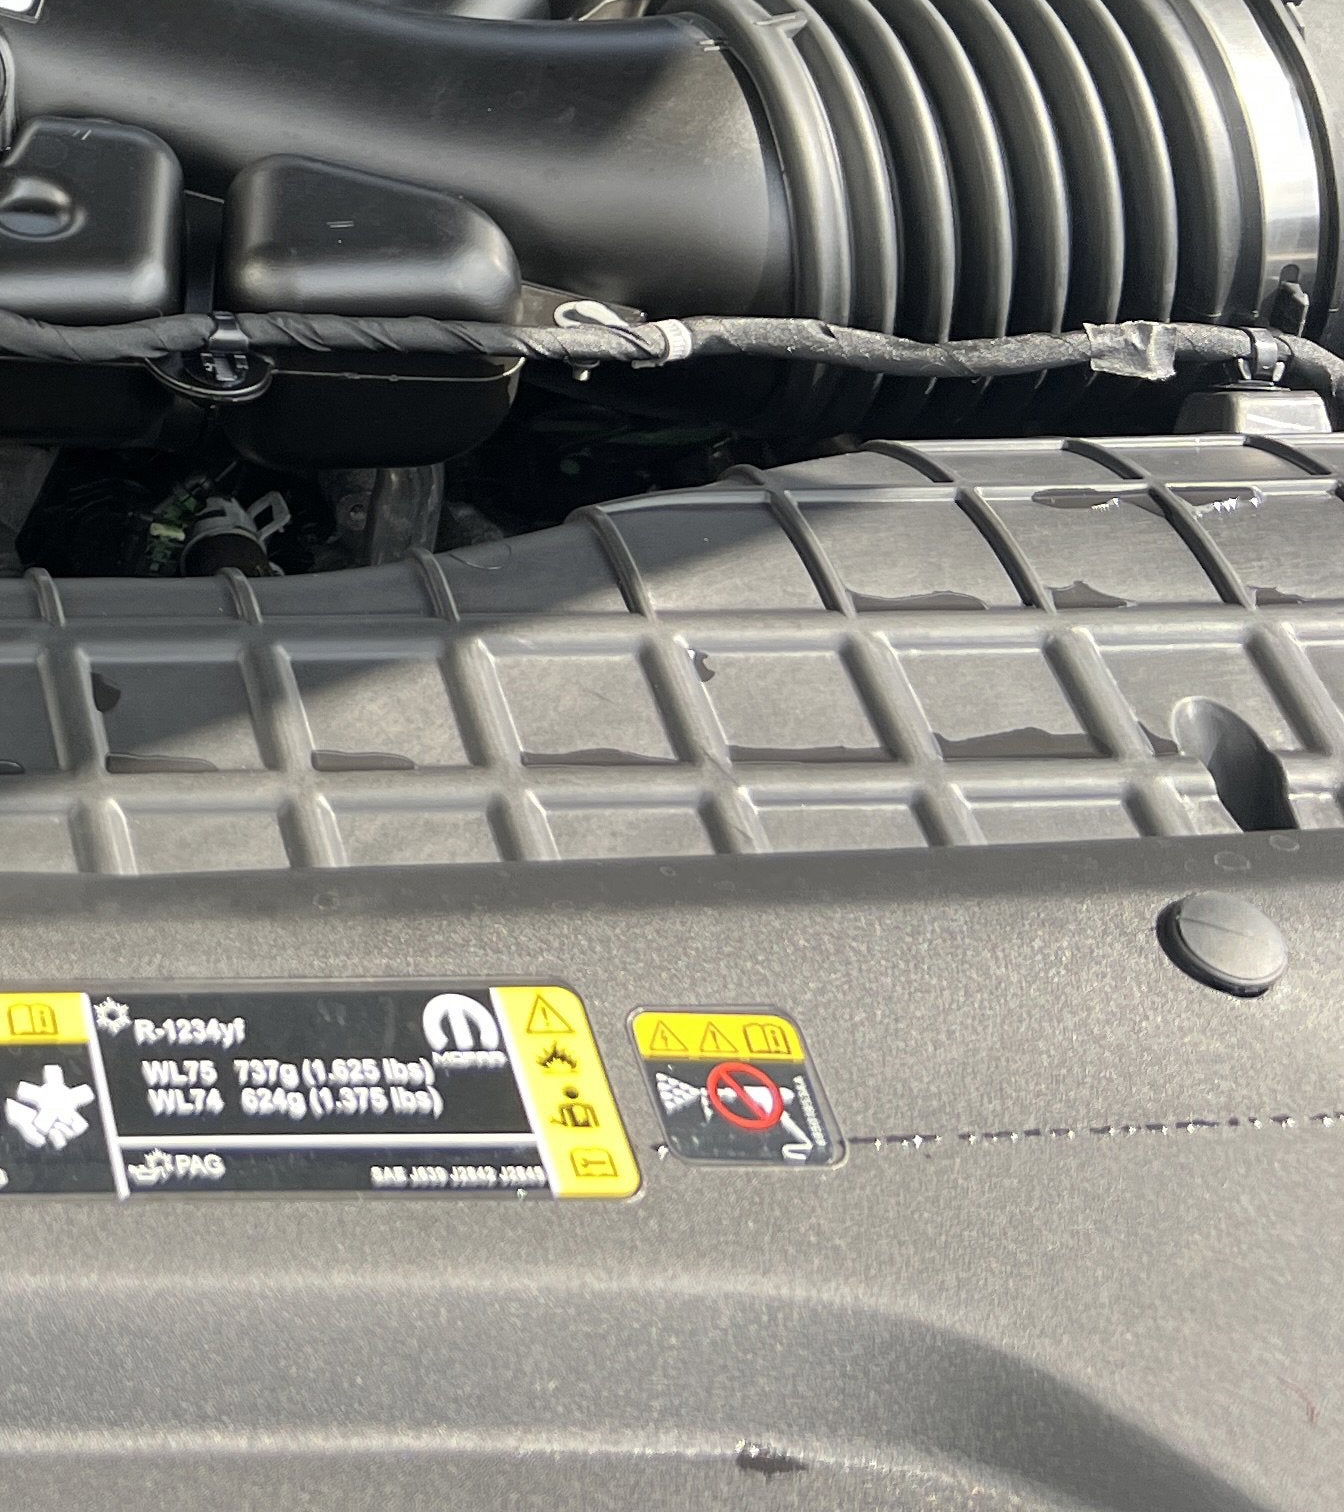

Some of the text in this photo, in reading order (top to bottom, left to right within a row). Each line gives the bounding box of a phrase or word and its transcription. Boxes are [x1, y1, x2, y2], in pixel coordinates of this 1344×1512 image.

[134, 1018, 245, 1049] R-1234yf
[141, 1058, 435, 1088] WL75 737g (1.625 lbs)
[148, 1087, 443, 1119] WL74 624g (1.375 lbs)
[175, 1154, 225, 1179] PAG
